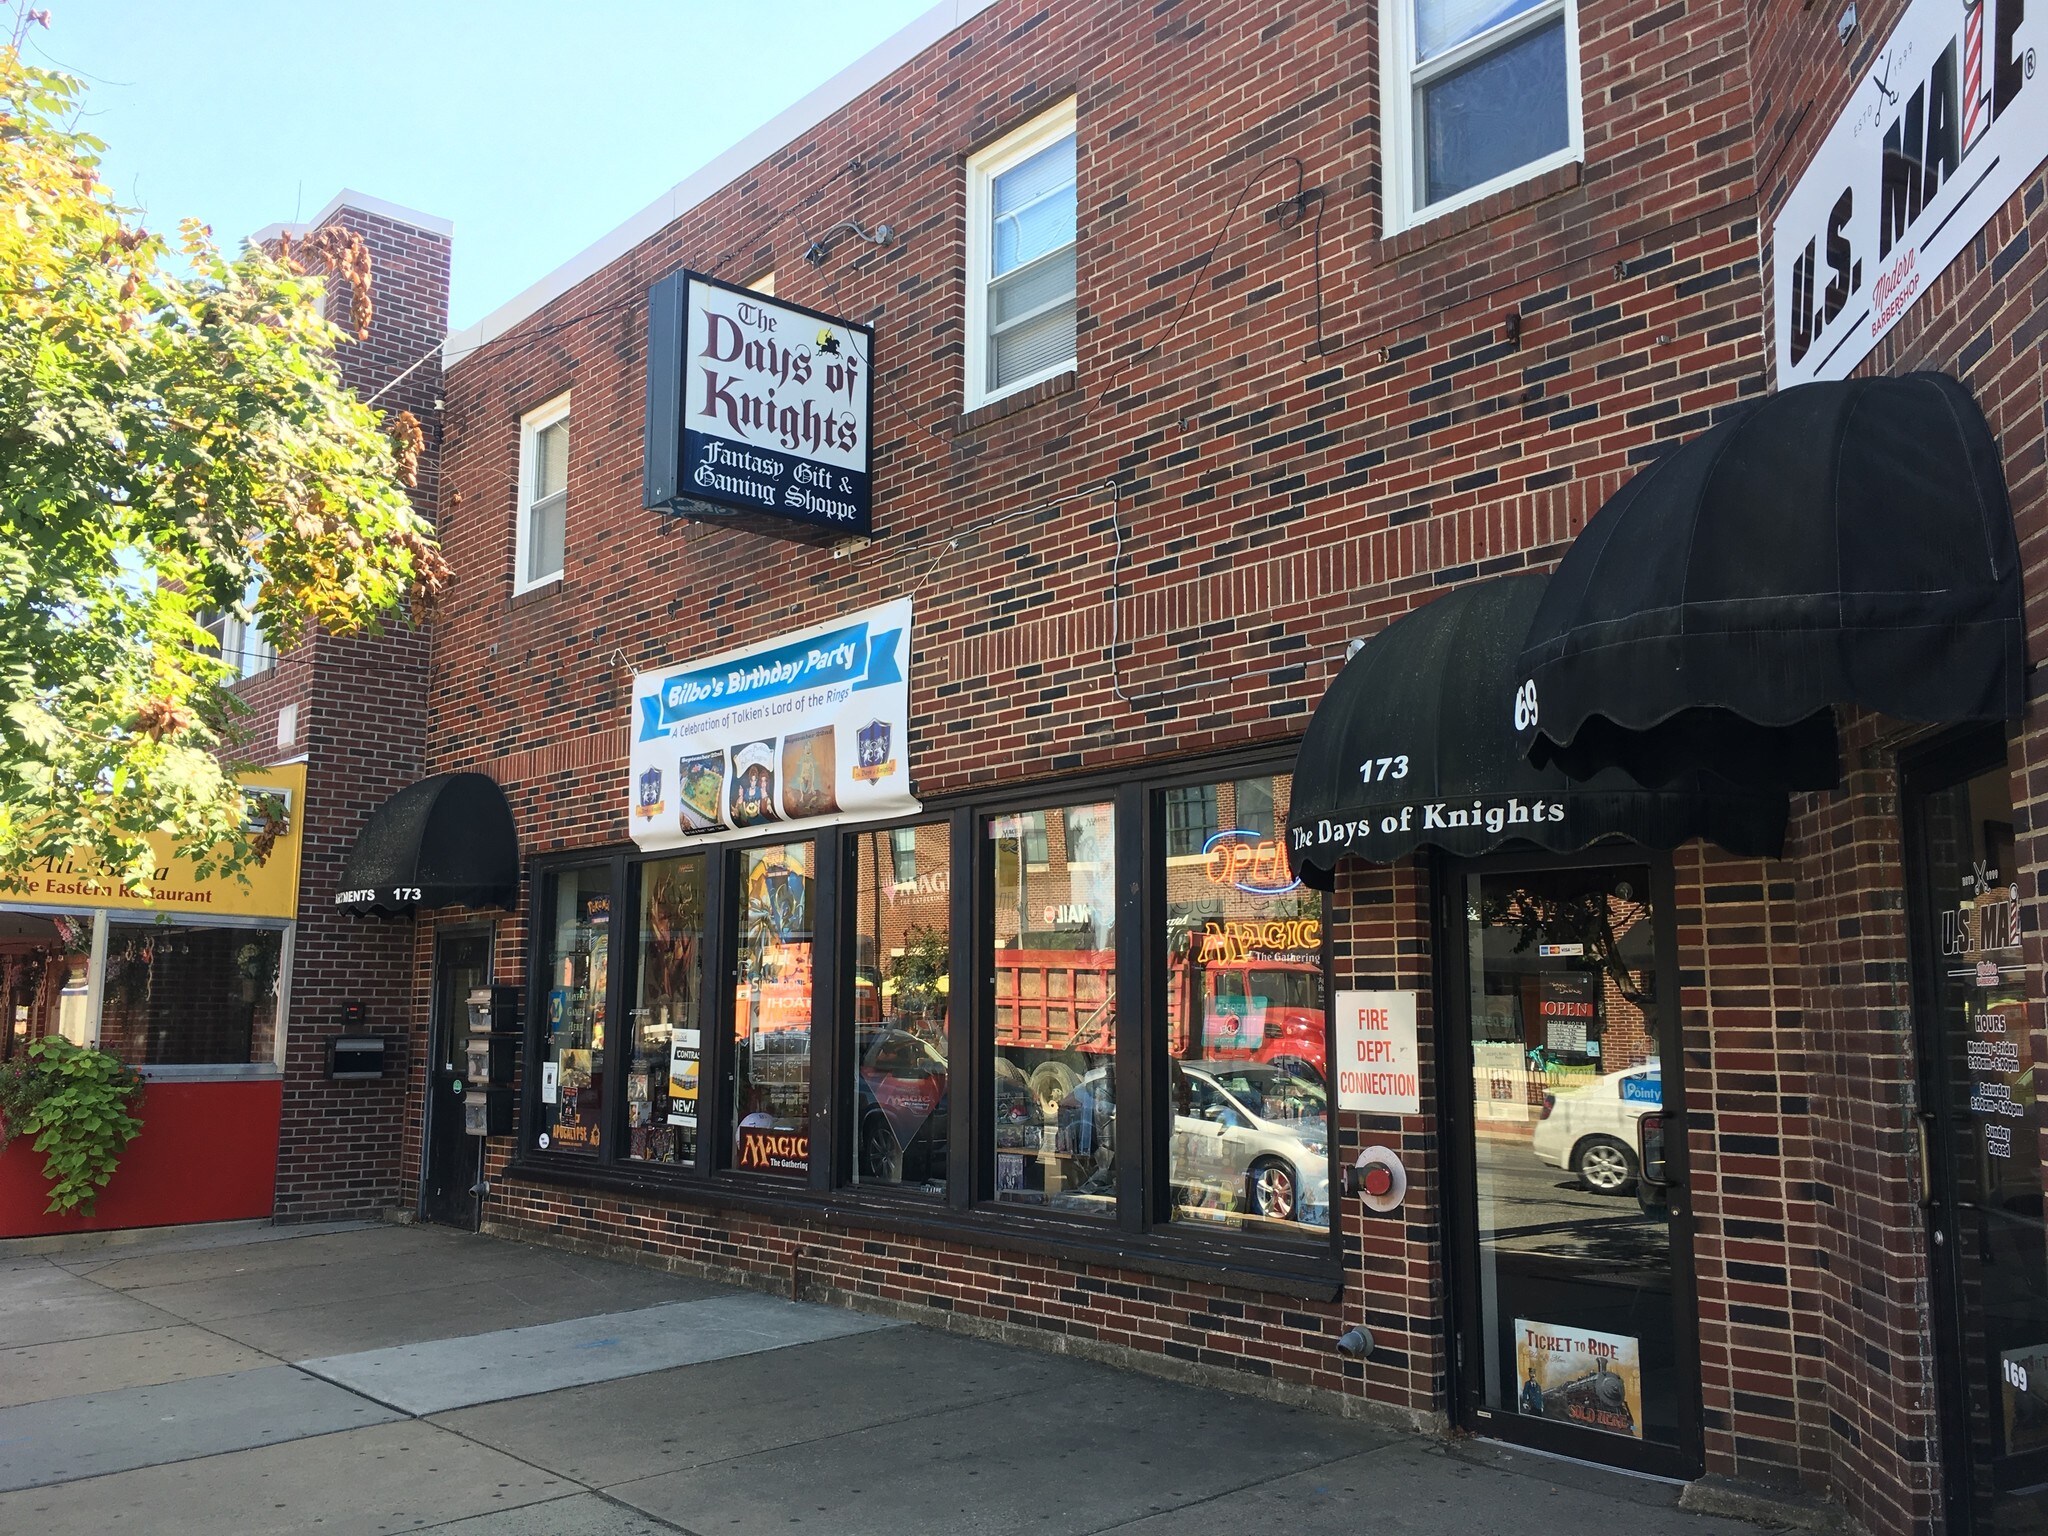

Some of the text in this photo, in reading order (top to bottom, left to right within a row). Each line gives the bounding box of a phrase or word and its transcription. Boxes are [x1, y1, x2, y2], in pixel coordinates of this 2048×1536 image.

[1790, 184, 1862, 368] U.S.
[1872, 247, 1915, 312] Modern
[736, 302, 777, 332] The
[1871, 273, 1920, 338] BARBERSHOP
[698, 306, 859, 407] Days of
[698, 365, 858, 455] Knights
[699, 440, 854, 495] Fantasy Gift &
[693, 465, 776, 505] Gaming
[784, 484, 858, 522] Shoppe
[668, 642, 856, 708] Bilbo's Birthday Party
[671, 687, 850, 738] A Celebration of Tolkien's Lord of the Rings
[1514, 678, 1538, 731] 69
[1359, 755, 1410, 784] 173
[1292, 797, 1566, 851] The Days of Knights
[46, 879, 112, 897] Eastern
[119, 883, 213, 904] Retaurant
[393, 887, 422, 901] 173
[1197, 919, 1321, 967] MAGIC
[1942, 908, 1975, 956] U.S.
[1254, 951, 1321, 965] The Gathering
[1358, 1008, 1389, 1031] FIRE
[1544, 1001, 1588, 1017] OPEN
[1975, 1014, 2006, 1033] HOURS
[676, 1049, 700, 1060] CONTRA
[1357, 1040, 1396, 1063] DEPT.
[1340, 1071, 1416, 1097] CONNECTION
[1980, 1082, 2011, 1100] Saturday
[672, 1099, 695, 1115] NEW!
[552, 1124, 588, 1142] APOCALYPSE
[1985, 1123, 2011, 1142] Sunday
[741, 1134, 809, 1168] MAGIC
[1987, 1140, 2011, 1158] Closed
[770, 1158, 809, 1171] The Gathering
[1525, 1329, 1572, 1353] TICKET
[1574, 1340, 1586, 1353] TO
[1588, 1338, 1619, 1361] RIDE
[2003, 1358, 2028, 1392] 169
